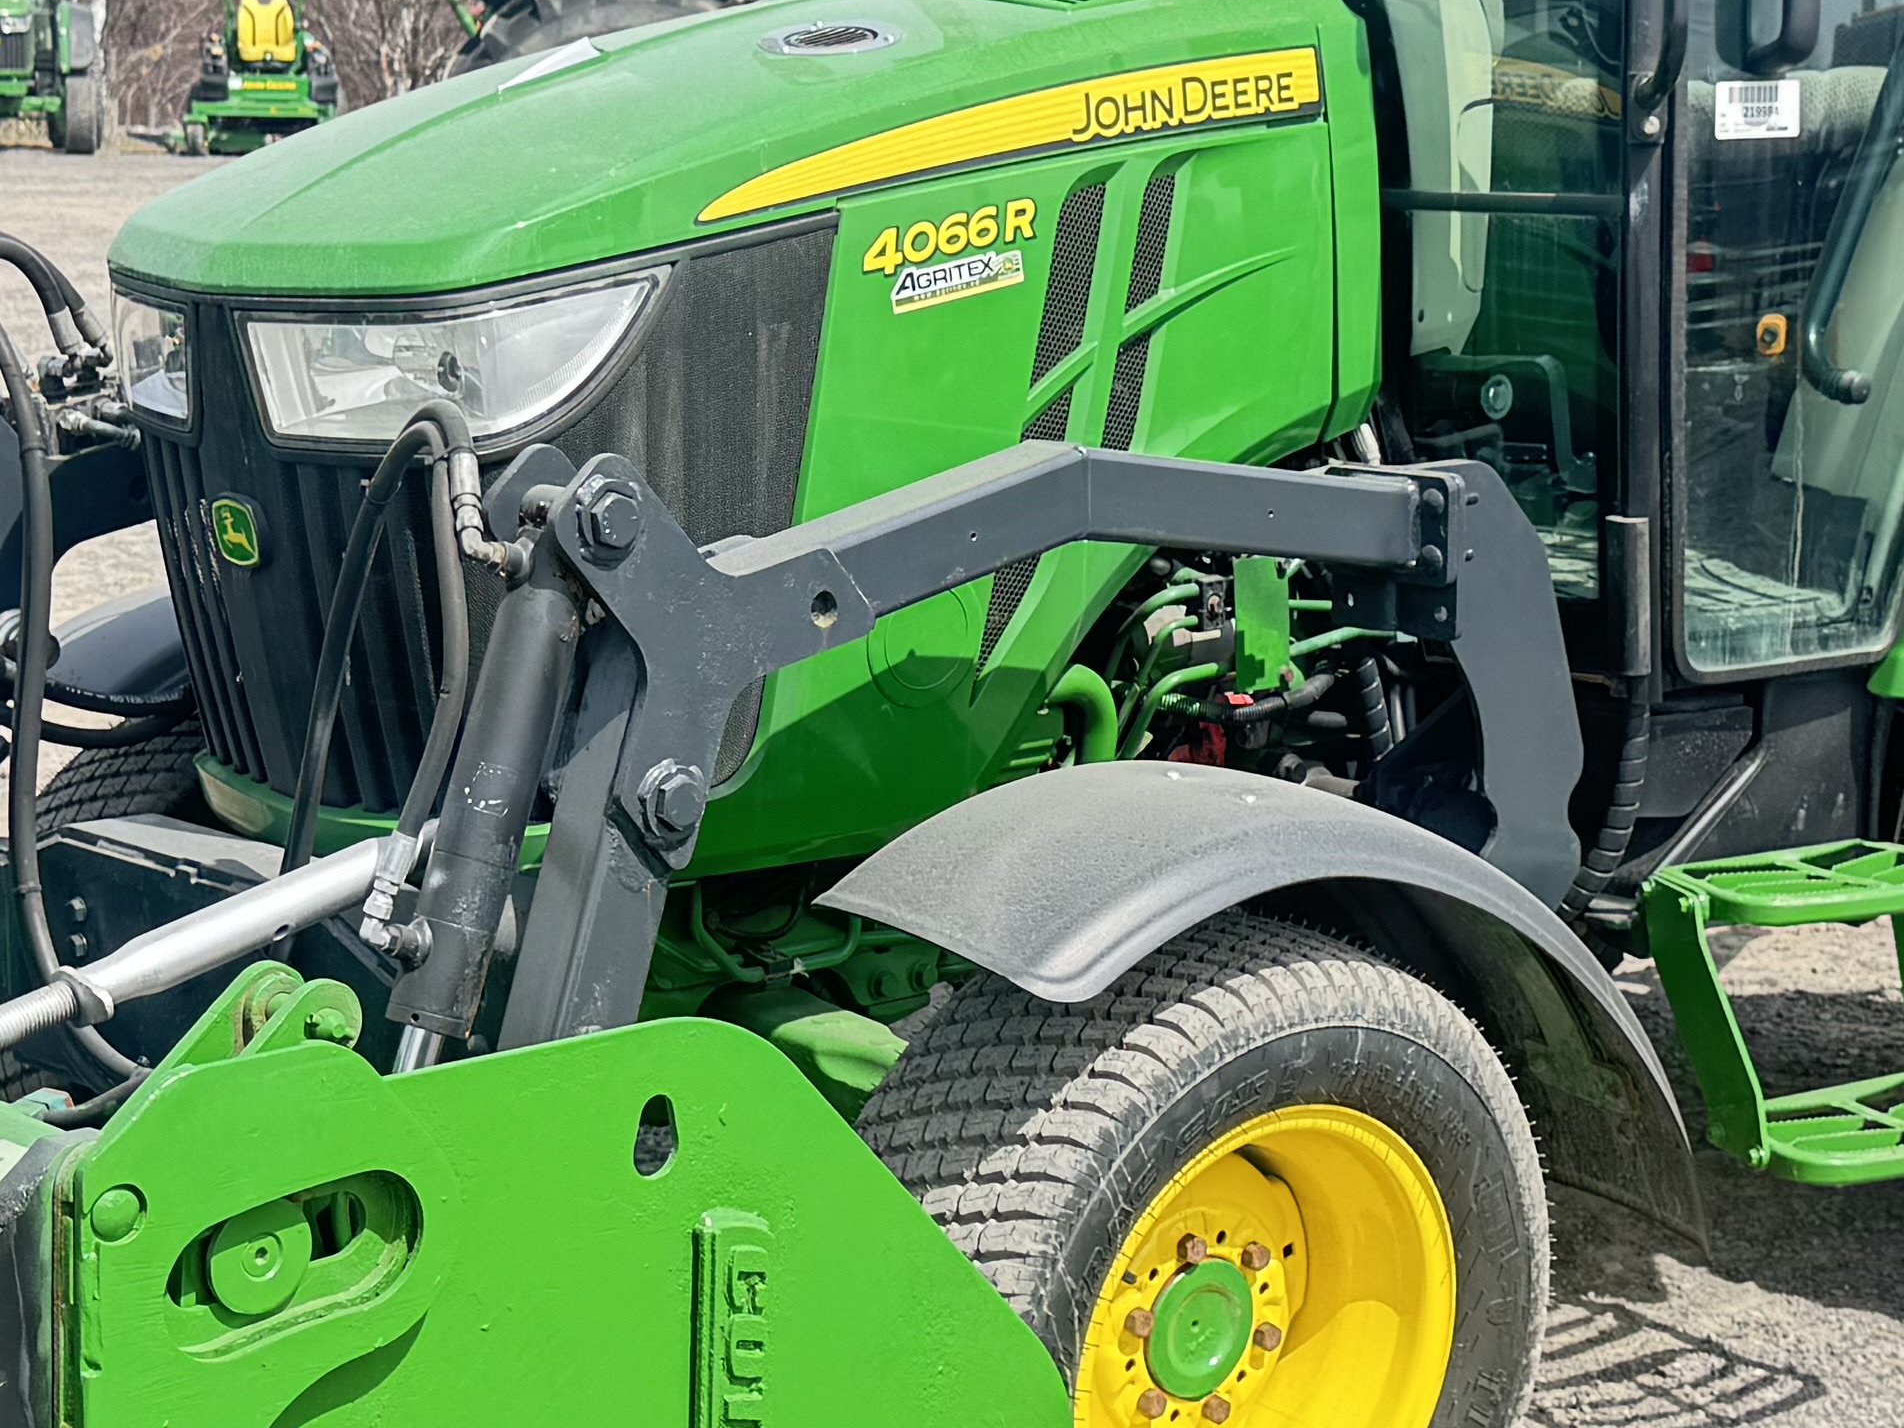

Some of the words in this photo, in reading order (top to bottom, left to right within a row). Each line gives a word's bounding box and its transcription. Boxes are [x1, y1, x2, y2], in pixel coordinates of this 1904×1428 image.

[1072, 87, 1175, 135] JOHN
[1181, 72, 1295, 117] DEERE
[895, 255, 995, 295] AGRITEX
